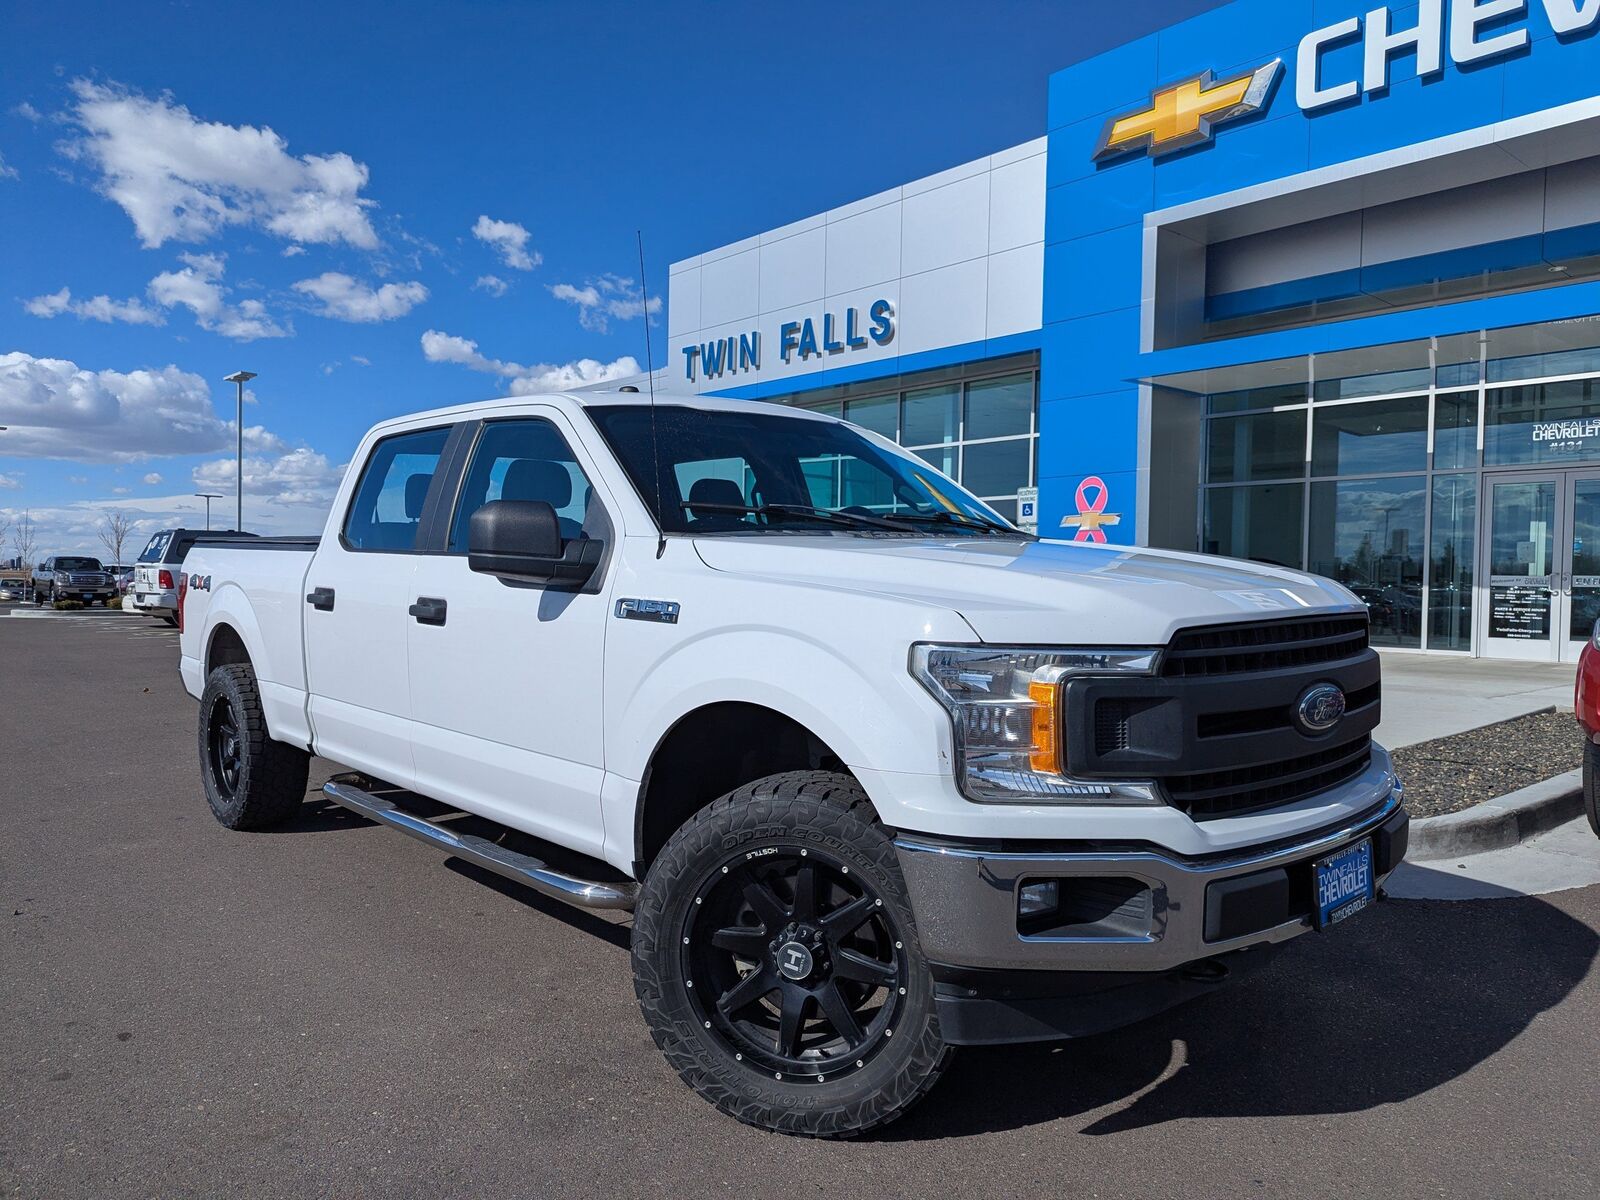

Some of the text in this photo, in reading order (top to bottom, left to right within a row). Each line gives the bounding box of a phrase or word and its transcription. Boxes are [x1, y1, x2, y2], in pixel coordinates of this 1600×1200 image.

[682, 300, 895, 383] TWIN FALLS
[1533, 425, 1600, 441] CHEVROLET
[746, 848, 778, 860] HOSTILE
[1319, 855, 1368, 887] TWINFALLS
[1319, 866, 1368, 907] CHEVROLET
